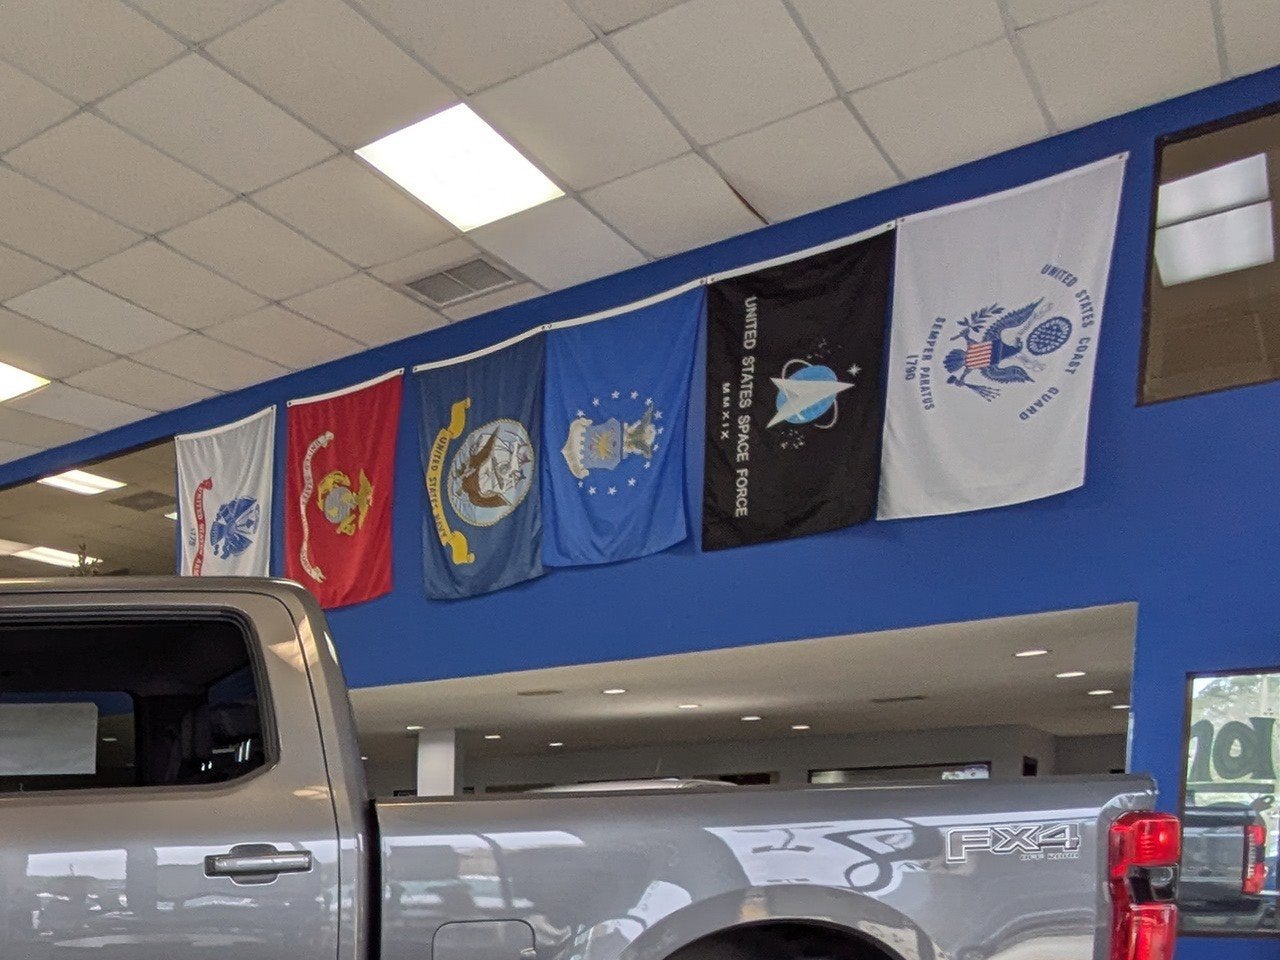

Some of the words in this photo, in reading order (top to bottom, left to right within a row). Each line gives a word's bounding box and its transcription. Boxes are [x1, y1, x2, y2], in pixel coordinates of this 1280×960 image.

[1041, 264, 1078, 287] UNITED
[743, 296, 758, 350] UNITED
[1075, 290, 1095, 328] STATES
[922, 317, 946, 361] SEMPER
[1064, 336, 1091, 375] COAST
[739, 355, 755, 409] STATES
[905, 354, 919, 381] 1790
[920, 366, 935, 411] PARATUS
[1019, 387, 1059, 420] GUARD
[431, 436, 448, 472] UNITED
[736, 414, 751, 463] SPACE
[734, 468, 749, 517] FORCE
[193, 557, 202, 577] ARM
[945, 822, 1082, 864] FX4
